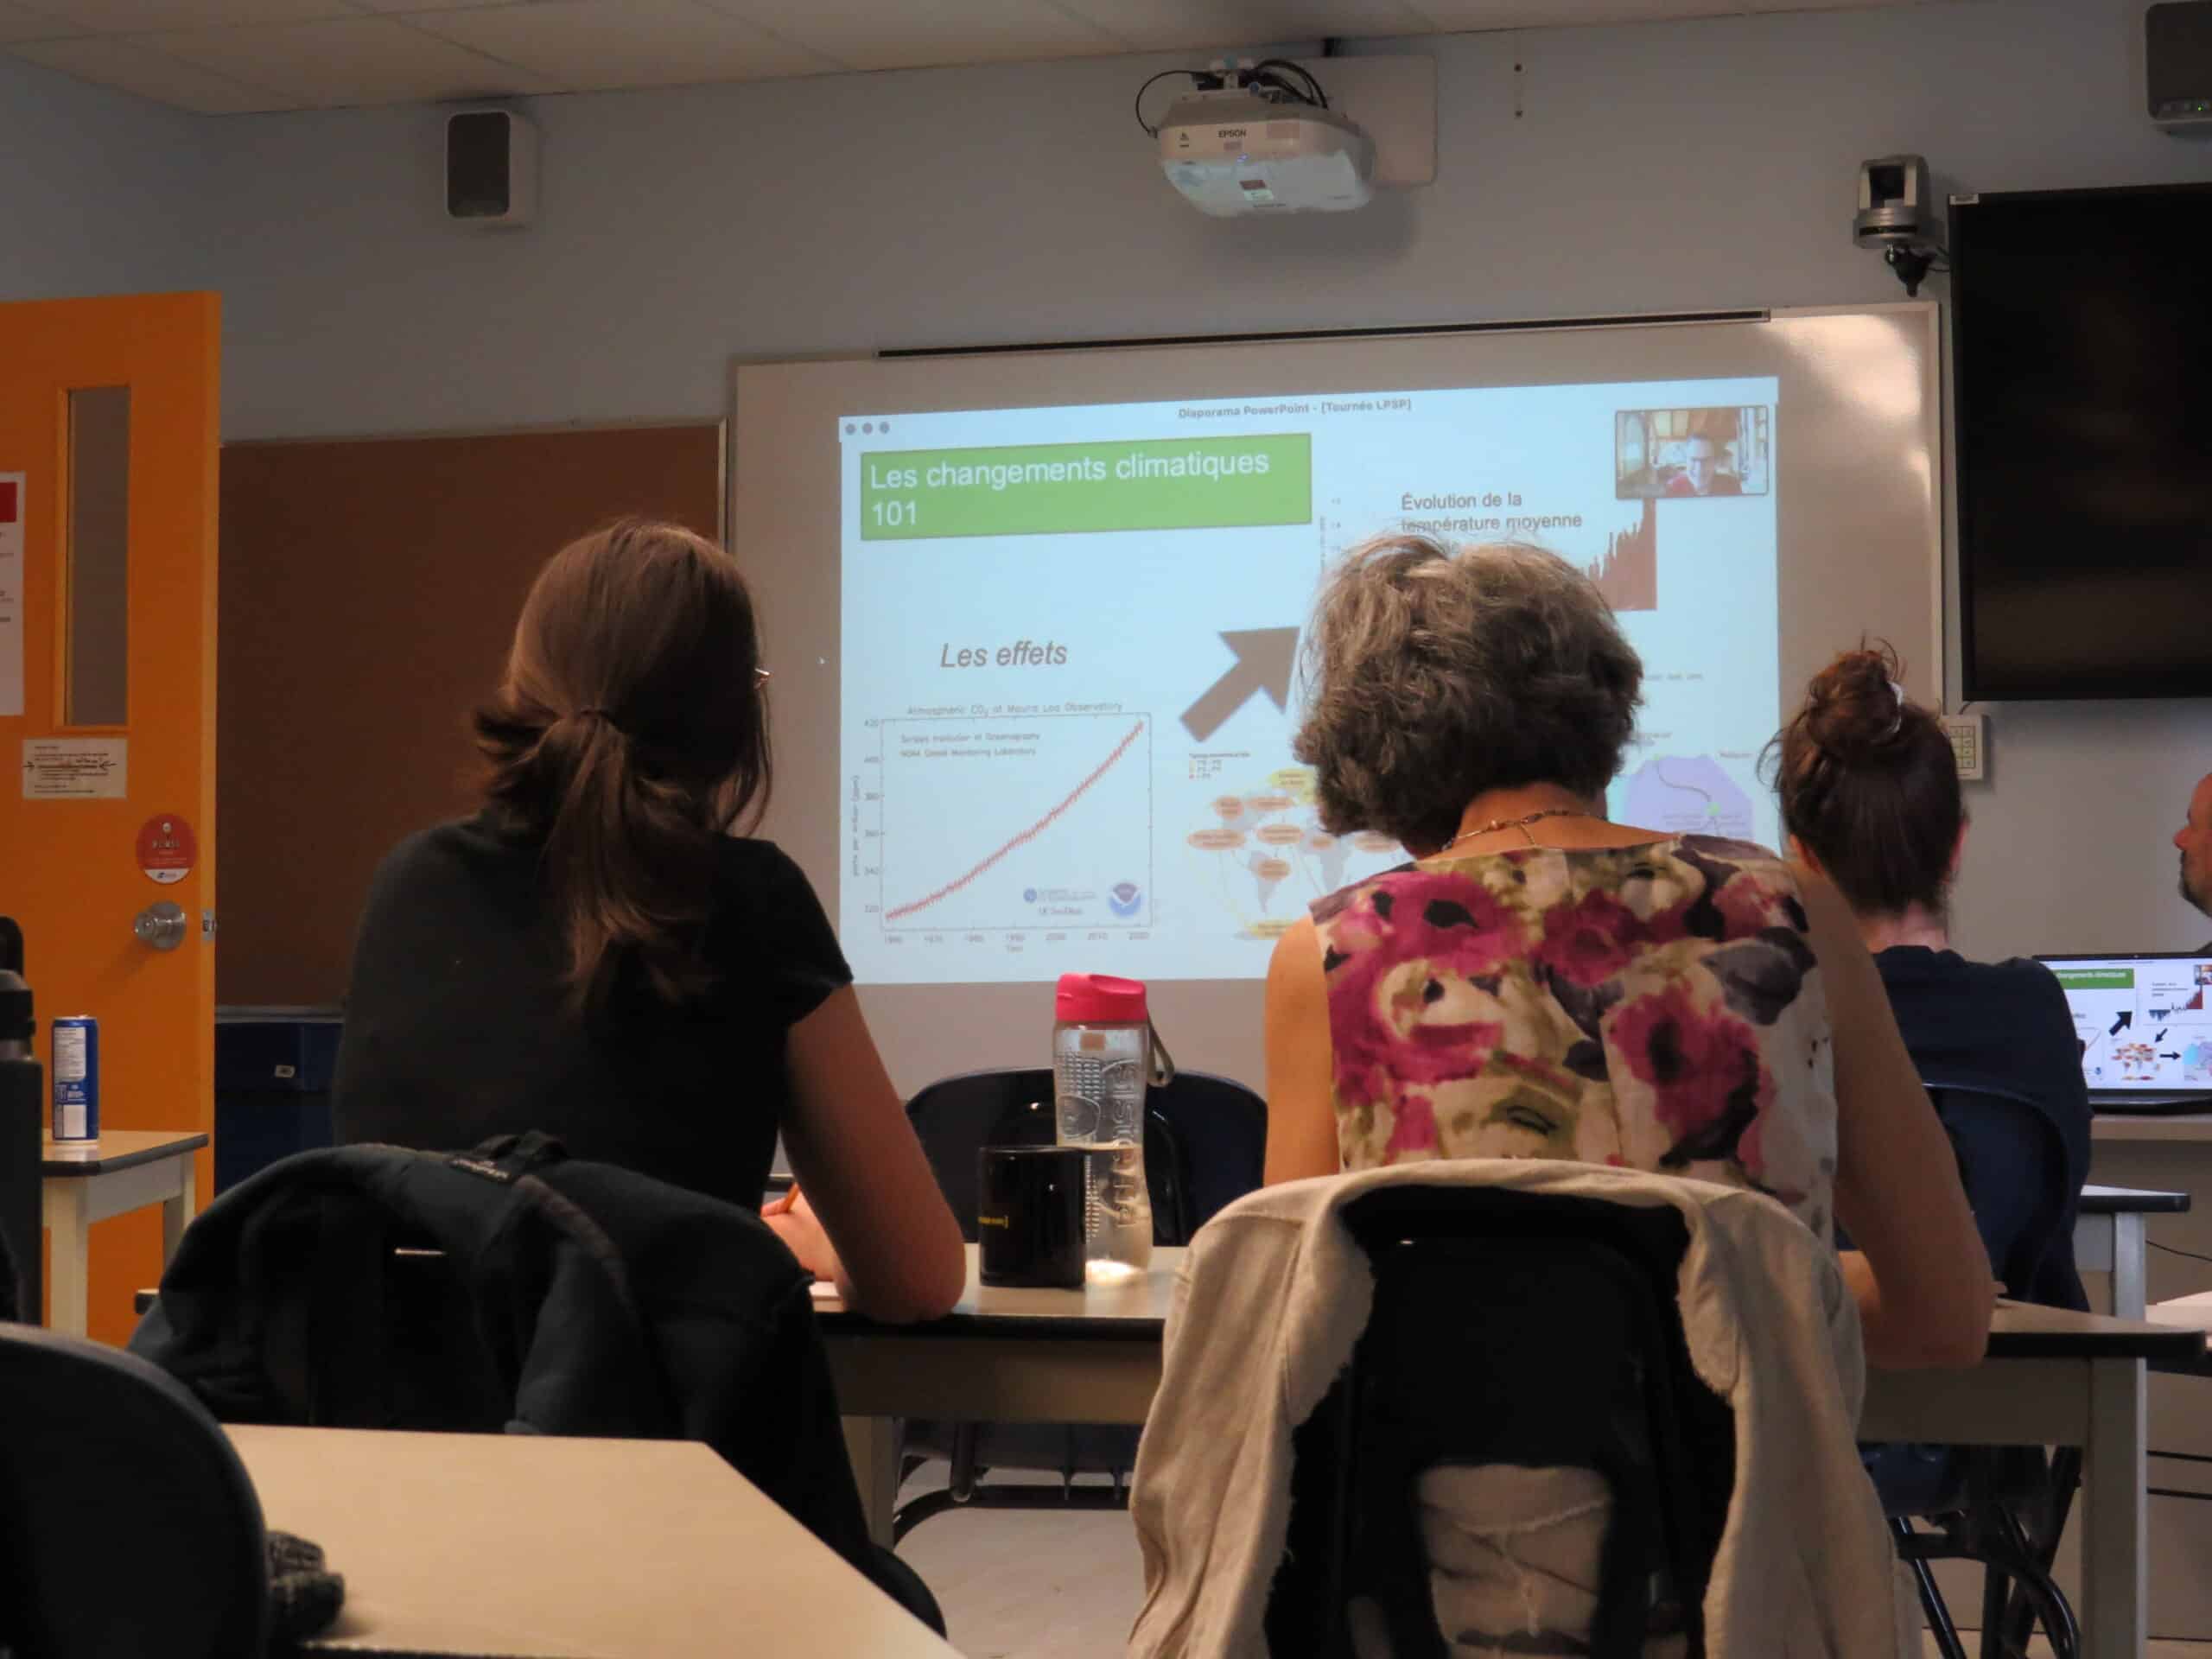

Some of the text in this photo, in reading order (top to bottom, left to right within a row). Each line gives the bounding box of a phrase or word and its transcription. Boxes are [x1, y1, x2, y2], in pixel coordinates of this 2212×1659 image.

[1217, 128, 1247, 138] EPSON
[1179, 407, 1240, 418] Diaporama
[1244, 404, 1309, 416] PowerPoint
[1321, 400, 1373, 414] [Tournée
[1376, 398, 1412, 411] LPSP]
[871, 450, 1270, 490] Les changements climatiques
[1402, 491, 1522, 511] Évolution de la
[872, 502, 916, 525] 101
[1402, 514, 1583, 534] température moyenne
[940, 639, 1068, 668] Les effets
